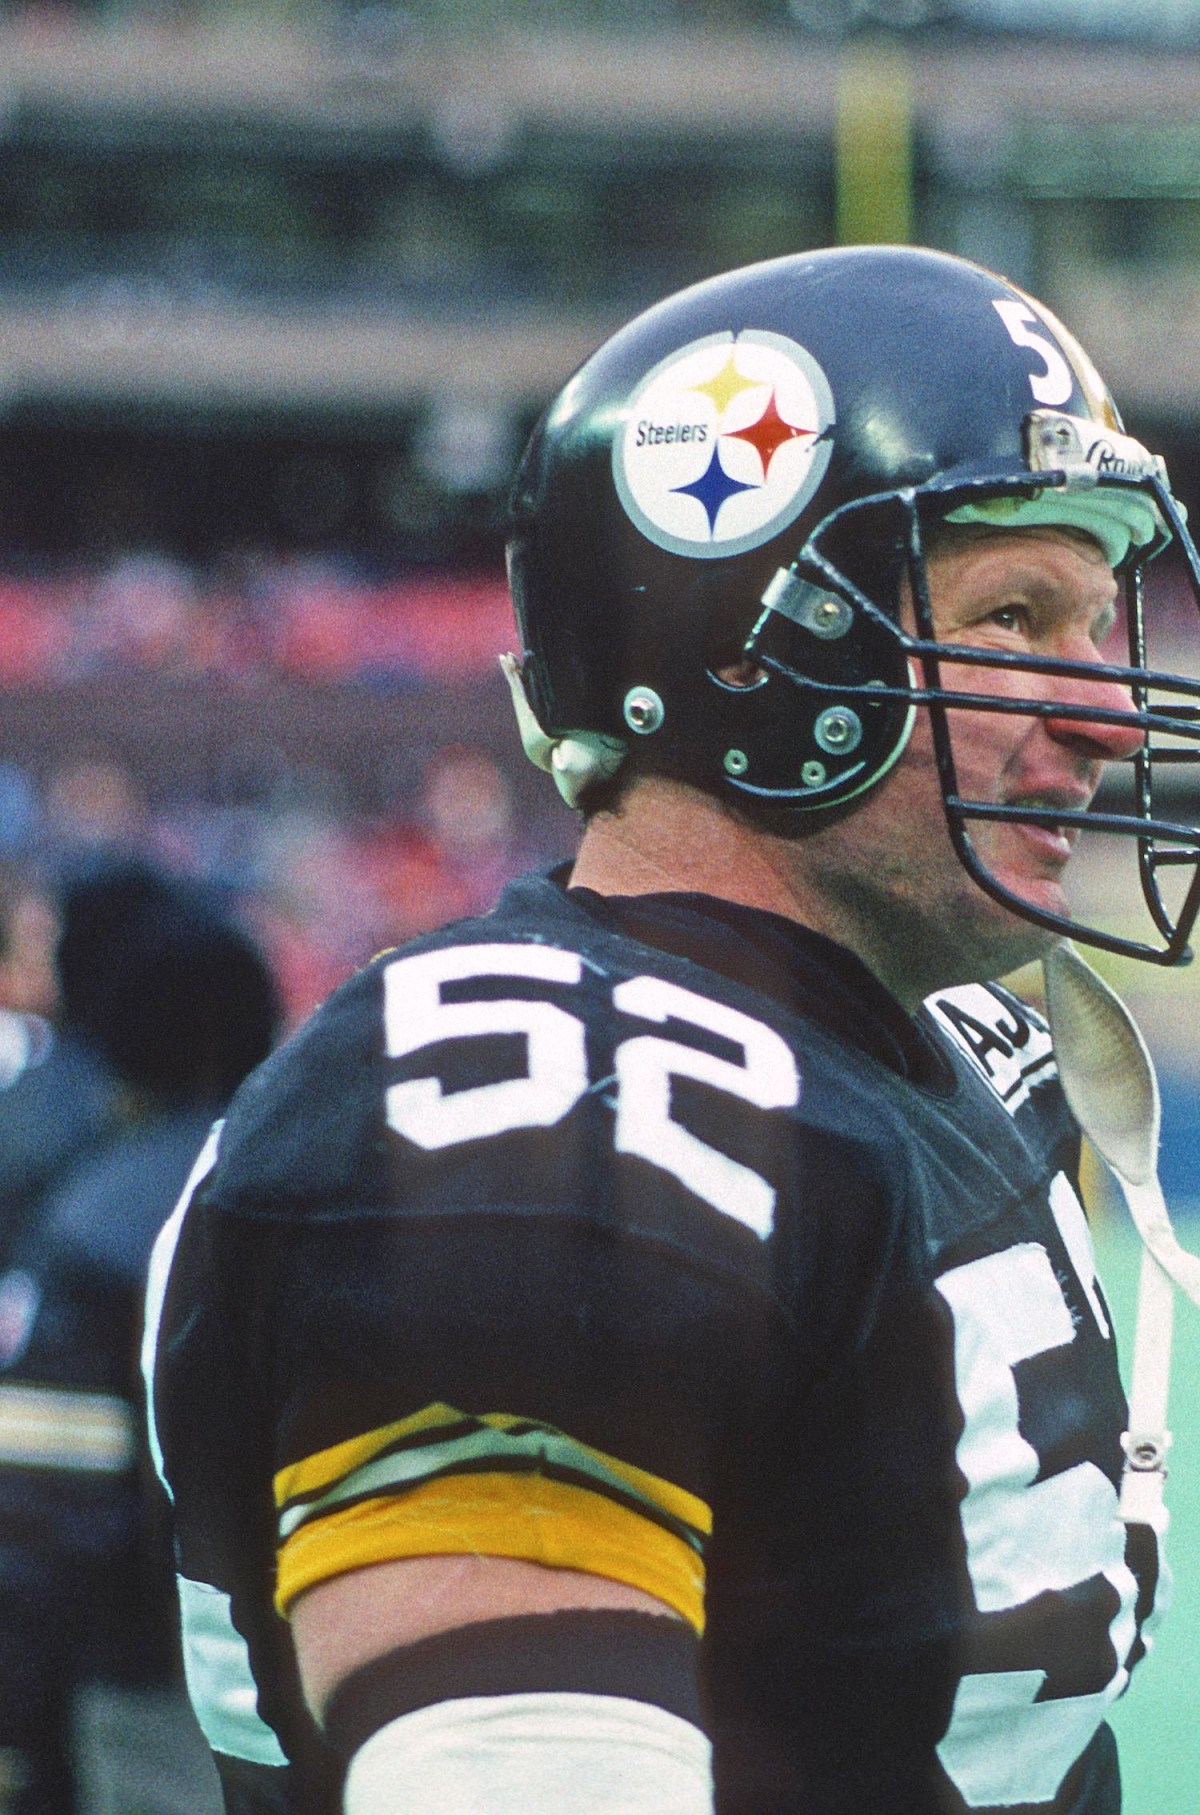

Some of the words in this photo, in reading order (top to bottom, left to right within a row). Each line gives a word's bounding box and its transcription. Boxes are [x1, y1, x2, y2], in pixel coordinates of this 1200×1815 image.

[991, 300, 1073, 405] 5
[636, 420, 708, 447] Steelers
[384, 943, 802, 1241] 52
